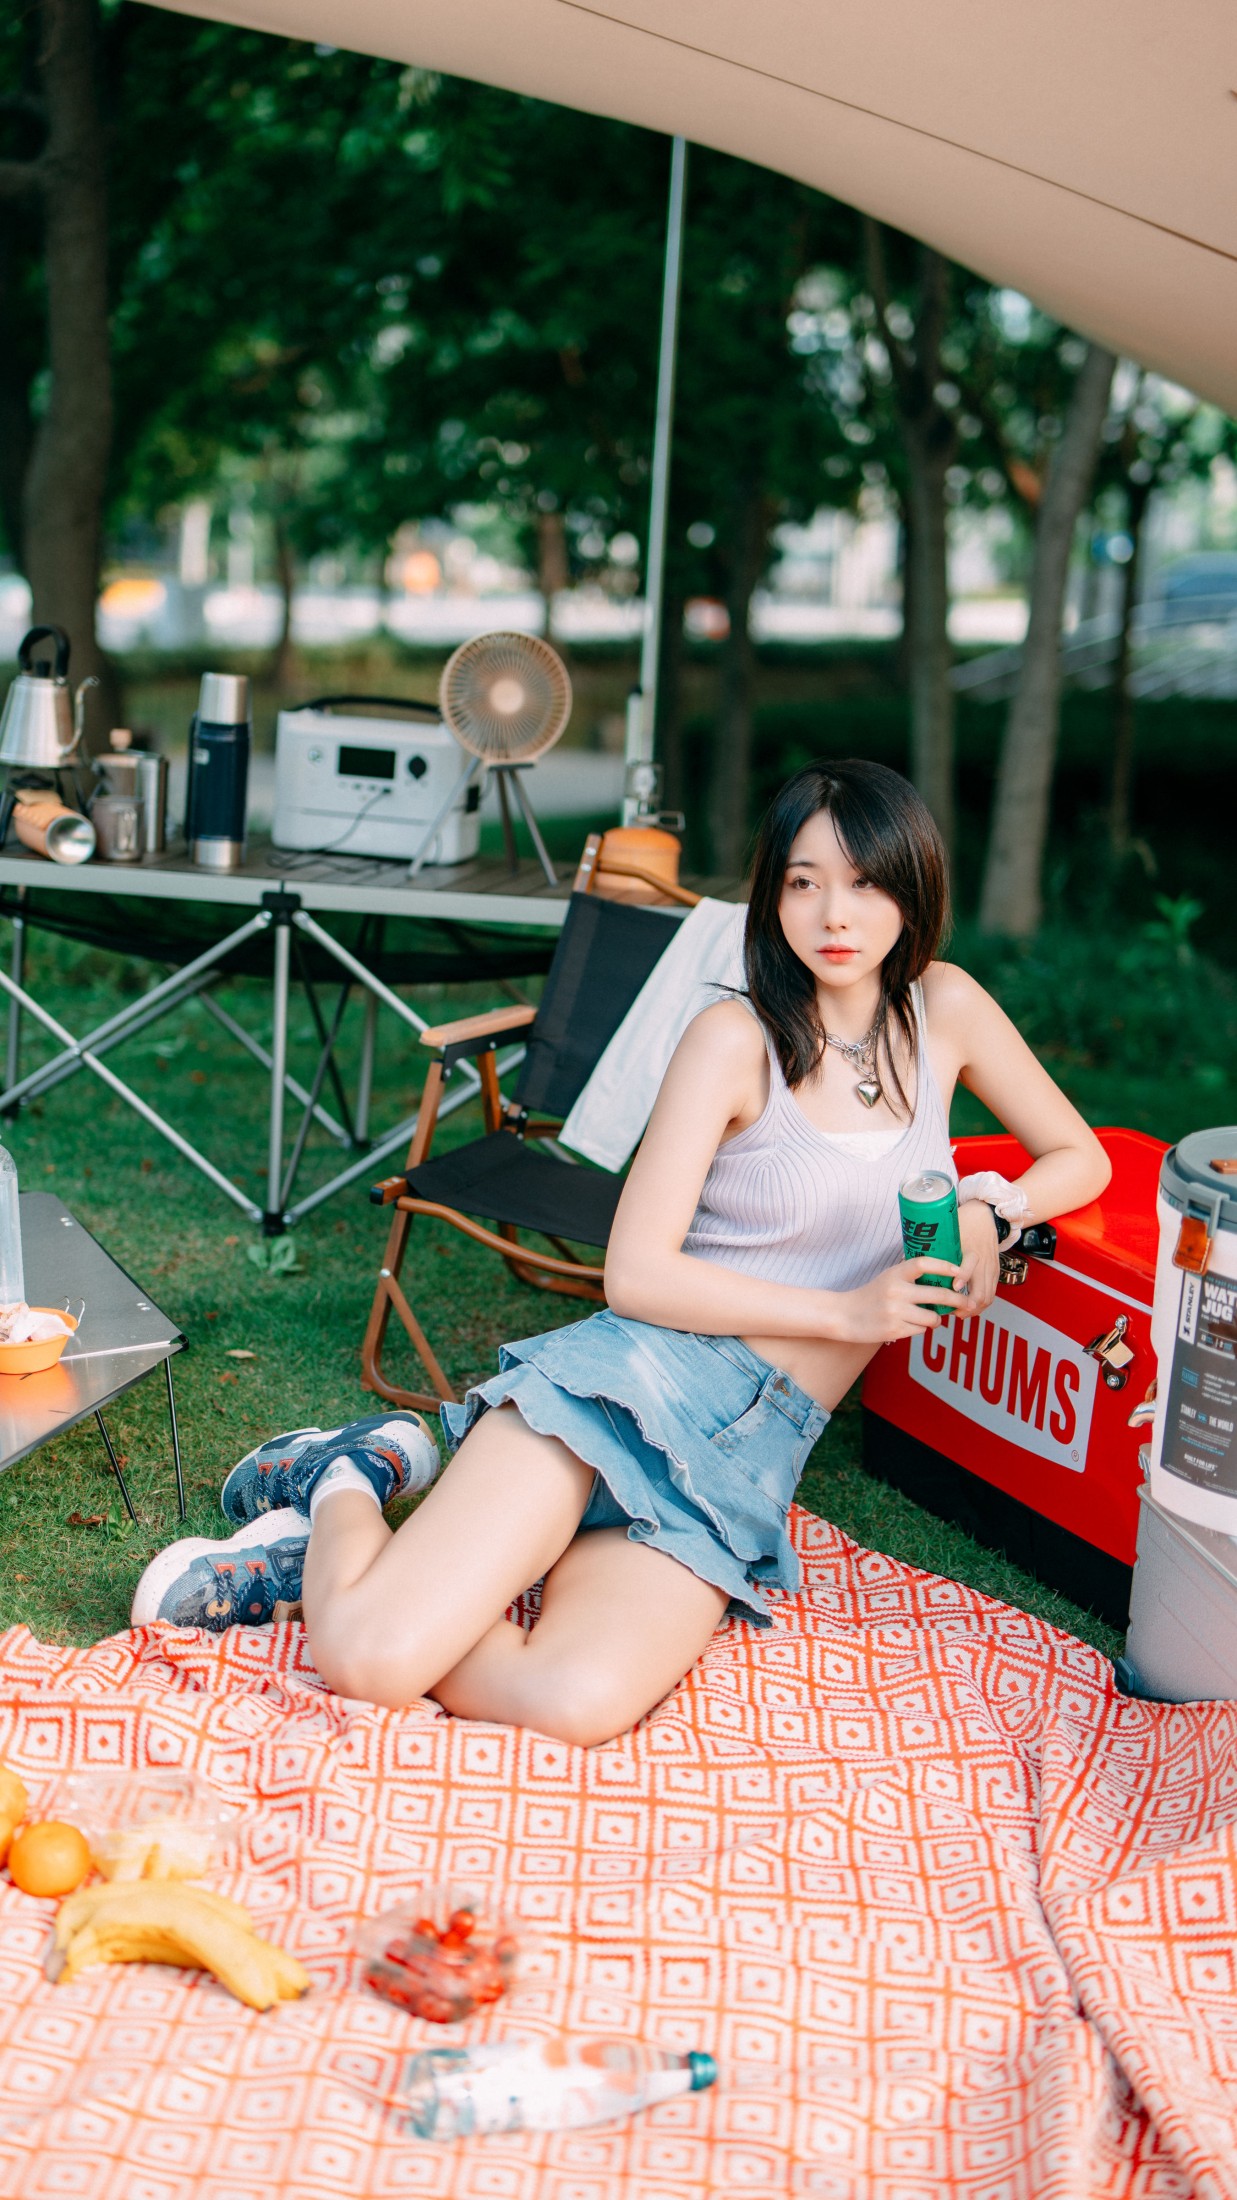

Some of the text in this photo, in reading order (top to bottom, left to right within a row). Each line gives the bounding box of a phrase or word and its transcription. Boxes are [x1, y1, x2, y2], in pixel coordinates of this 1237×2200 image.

[1185, 1281, 1195, 1323] STANLEY
[1204, 1281, 1237, 1307] WAT
[1201, 1299, 1234, 1323] JUG
[923, 1314, 1080, 1445] CHUMS
[1180, 1403, 1197, 1419] STANLEY
[1209, 1415, 1217, 1428] THE
[1217, 1418, 1234, 1433] WORLD
[1184, 1453, 1196, 1463] BUILT
[1196, 1458, 1205, 1467] FOR
